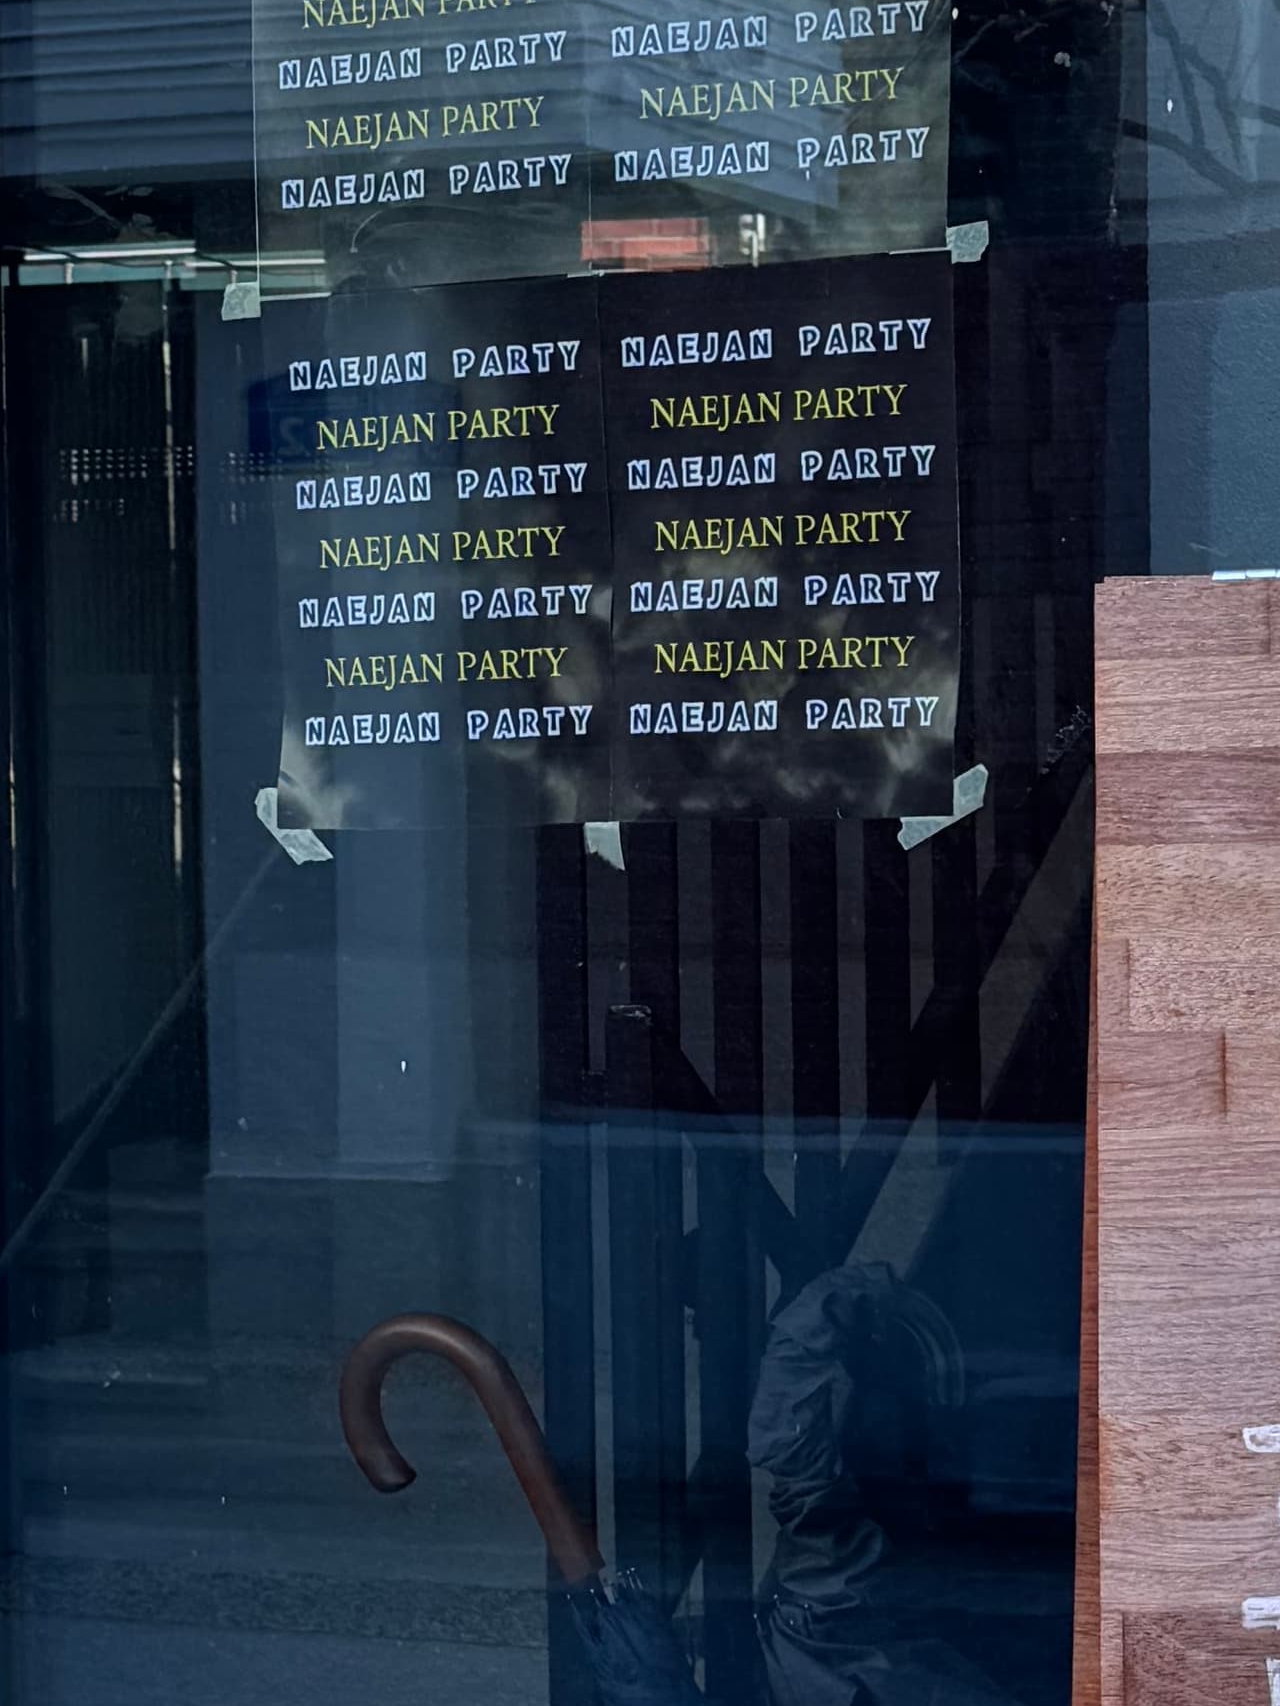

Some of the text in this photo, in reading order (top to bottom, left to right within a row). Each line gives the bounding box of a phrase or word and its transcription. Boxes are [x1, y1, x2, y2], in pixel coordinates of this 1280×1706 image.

[610, 1, 929, 58] NAEJAN PARTY
[278, 32, 568, 91] NAEJAN PARTY
[639, 68, 904, 122] NAEJAN PARTY
[306, 96, 544, 151] NAEJAN PARTY
[614, 128, 929, 184] NAEJAN PARTY
[282, 154, 571, 211] NAEJAN PARTY
[289, 341, 580, 391] NAEJAN PARTY
[621, 318, 931, 368] NAEJAN PARTY
[317, 412, 436, 452] NAEJAN
[448, 405, 560, 442] PARTY
[650, 384, 908, 432] NAEJAN PARTY
[296, 464, 588, 511] NAEJAN PARTY
[627, 446, 935, 491] NAEJAN PARTY
[320, 526, 566, 572] NAEJAN PARTY
[655, 510, 912, 556] NAEJAN PARTY
[299, 584, 593, 628] NAEJAN PARTY
[629, 571, 941, 614] NAEJAN PARTY
[325, 648, 568, 691] NAEJAN PARTY
[654, 636, 915, 679] NAEJAN PARTY
[304, 705, 593, 746] NAEJAN PARTY
[629, 697, 939, 735] NAEJAN PARTY
